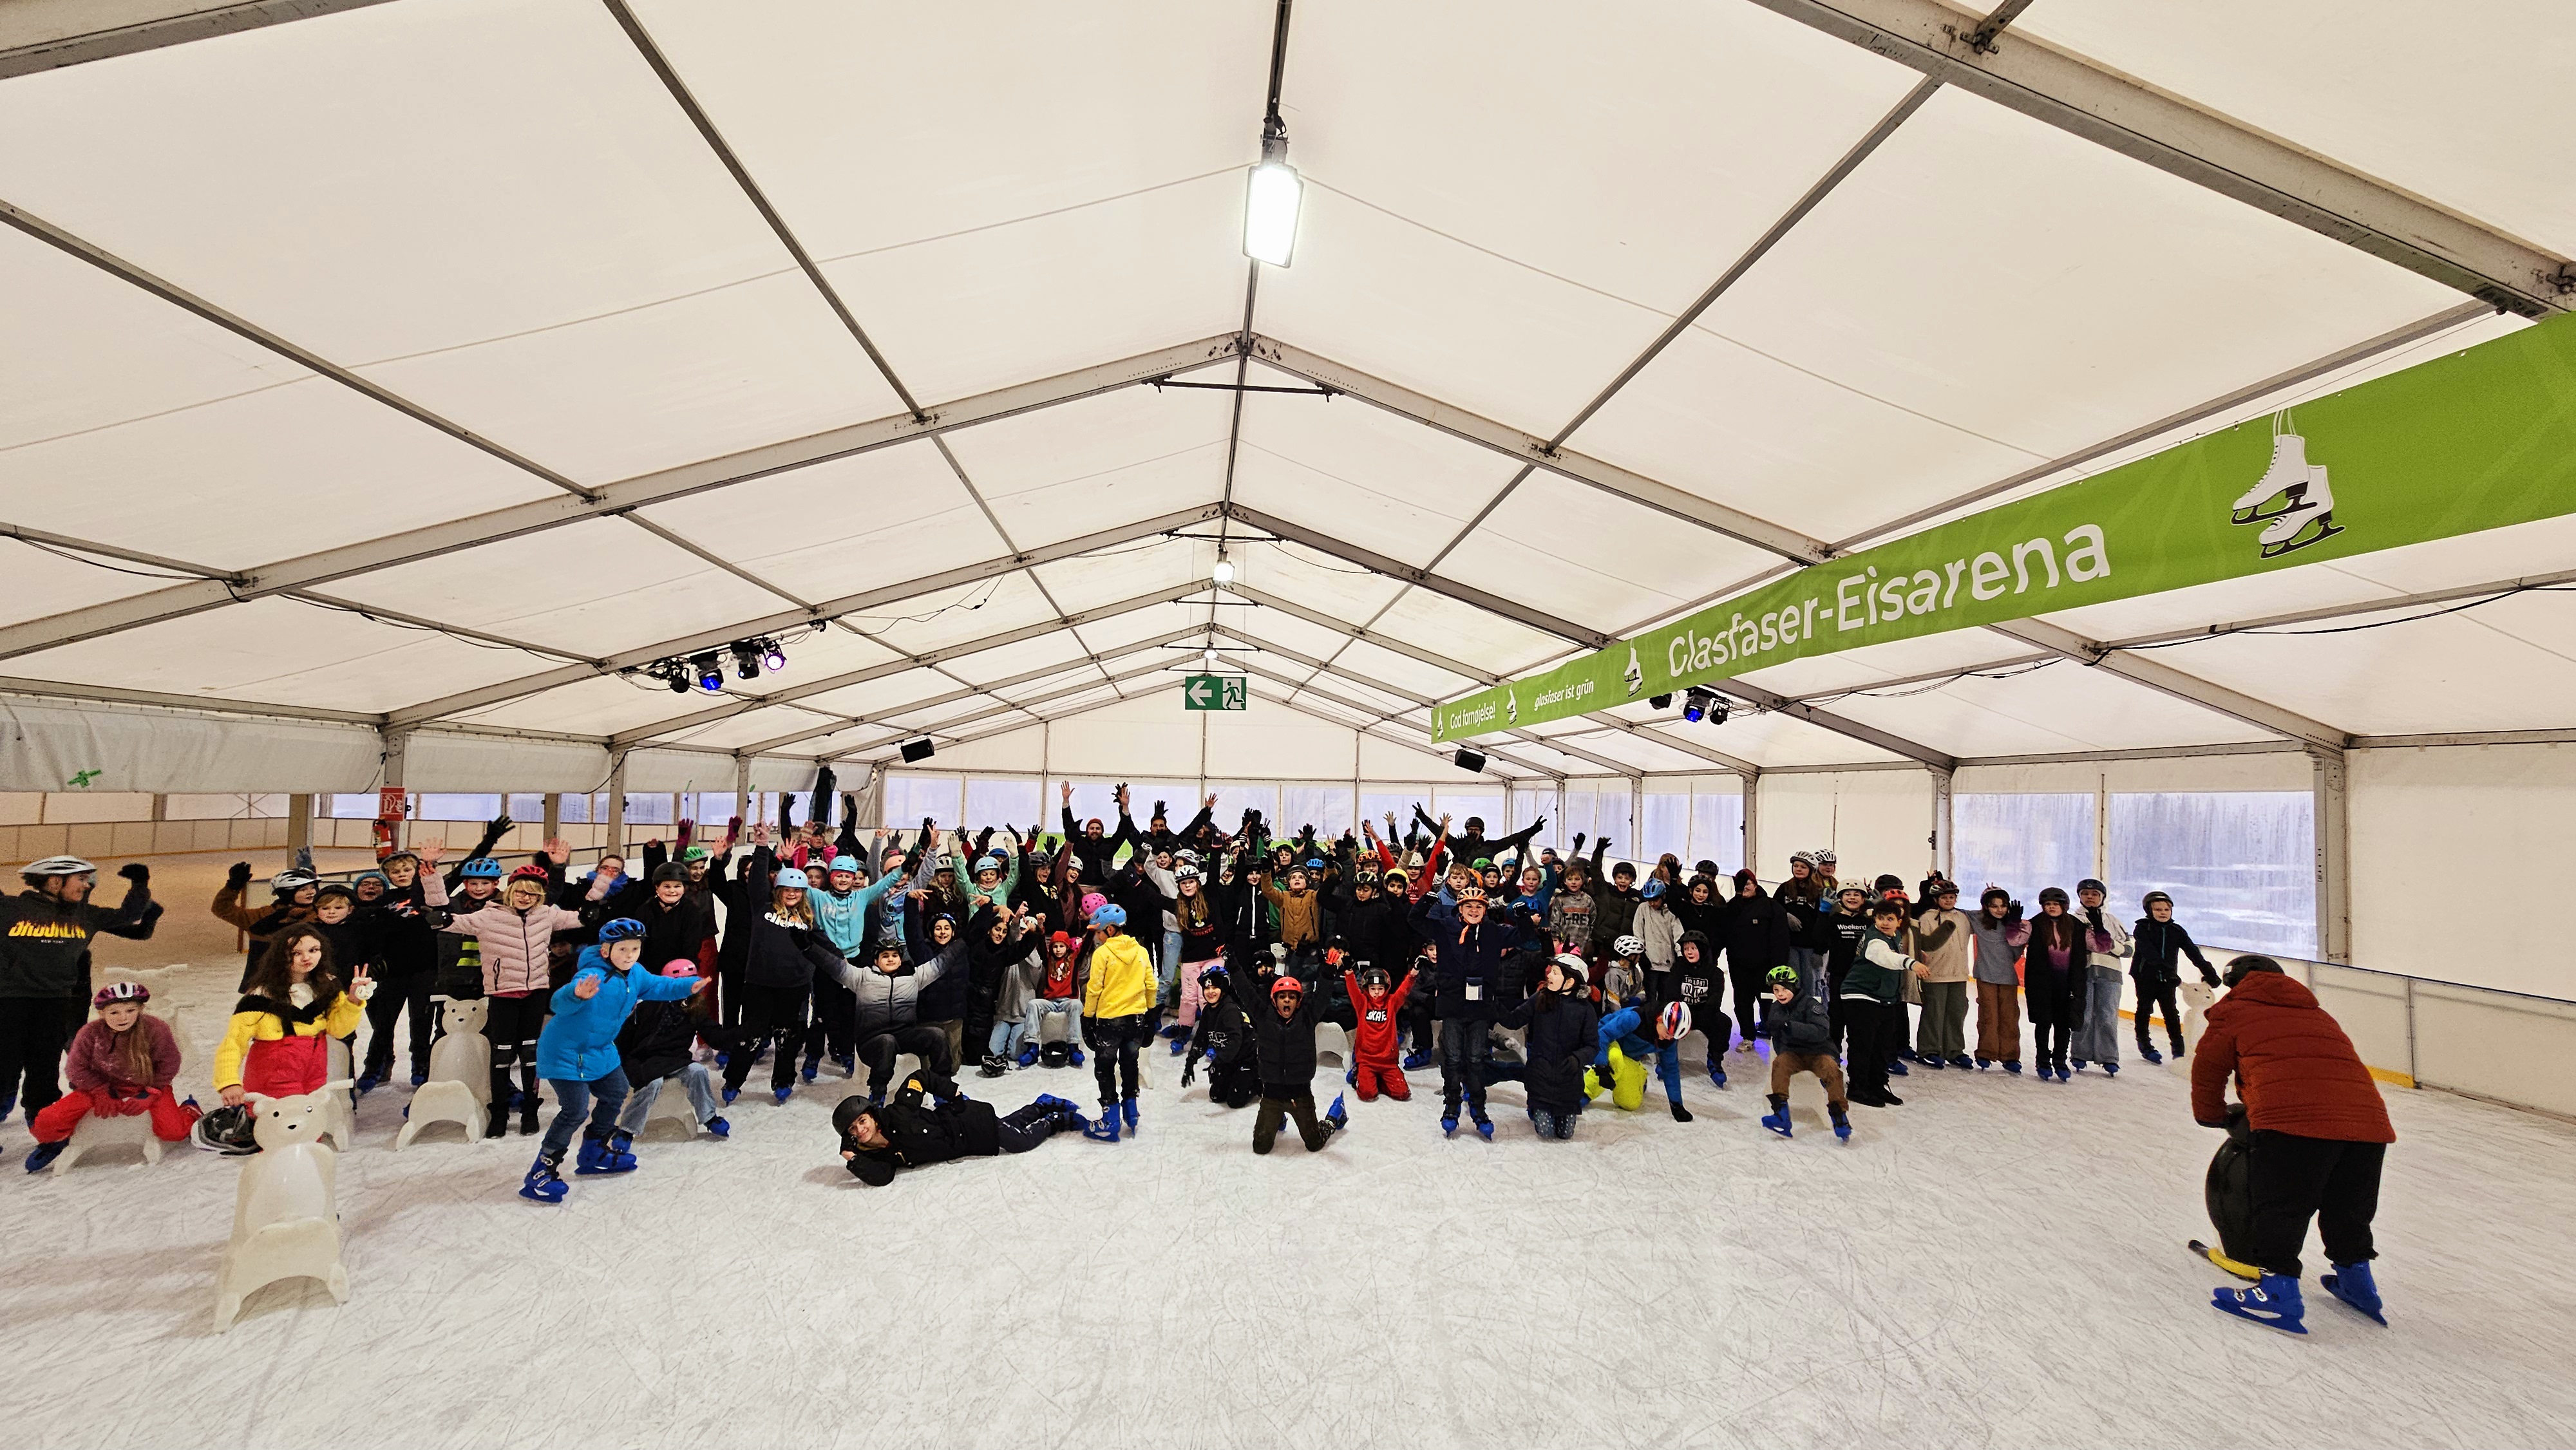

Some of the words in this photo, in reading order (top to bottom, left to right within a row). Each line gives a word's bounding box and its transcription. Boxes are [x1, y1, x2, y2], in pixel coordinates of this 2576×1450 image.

[1669, 523, 2111, 677] Glasfaser-Eisarena
[1534, 690, 1565, 711] glasfaser
[1565, 684, 1575, 700] ist
[1576, 678, 1594, 701] grün
[1450, 710, 1462, 730] God
[1562, 912, 1589, 926] T-RE
